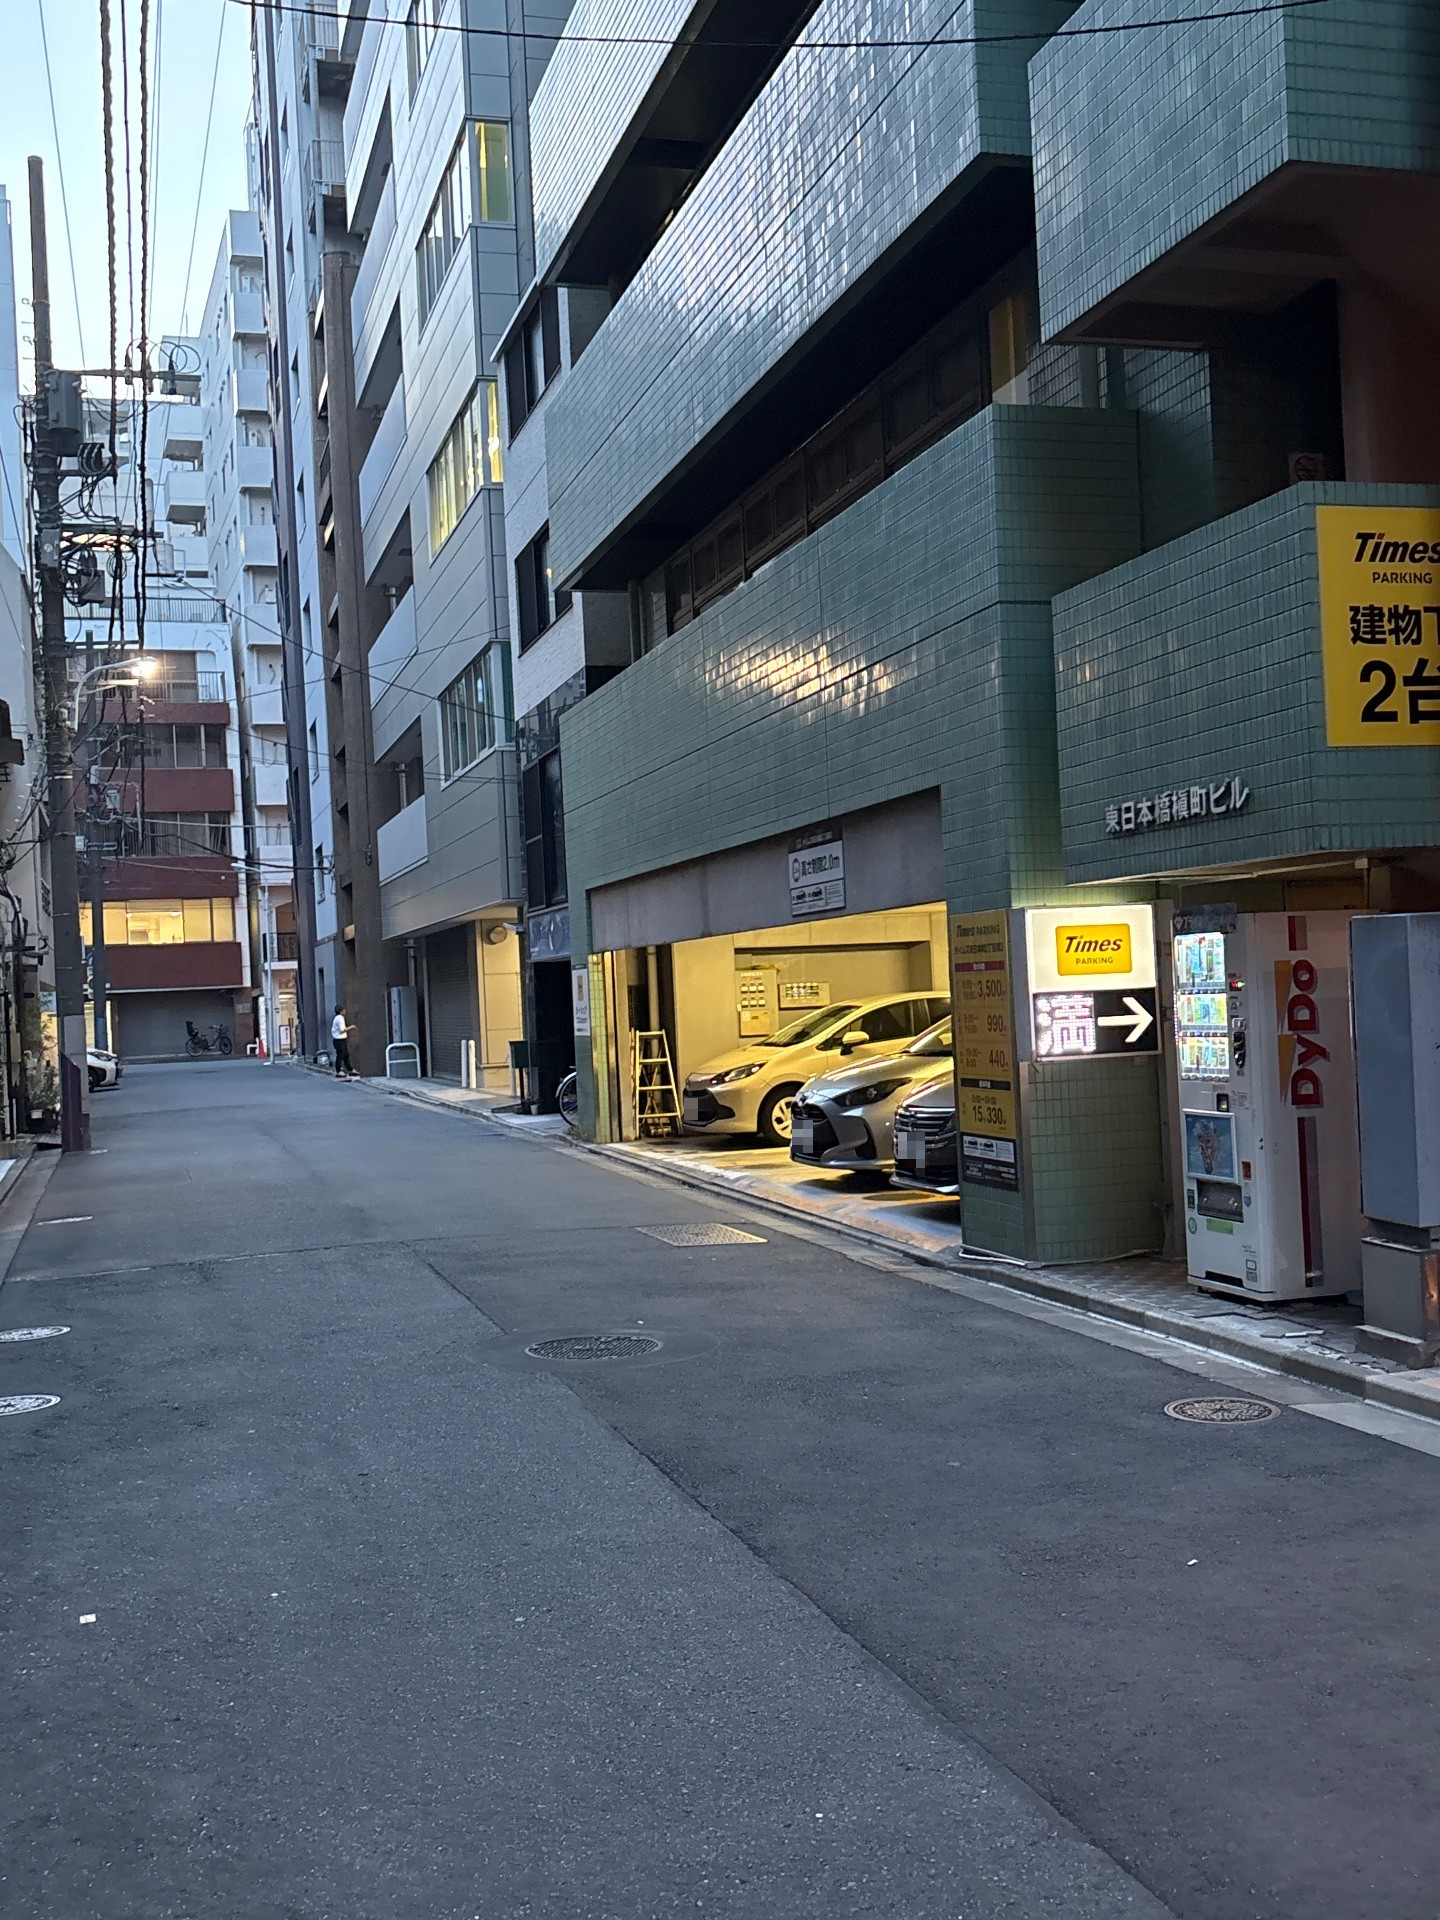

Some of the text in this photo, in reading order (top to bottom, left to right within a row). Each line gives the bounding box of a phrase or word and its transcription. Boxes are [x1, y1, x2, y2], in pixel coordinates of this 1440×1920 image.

[1354, 532, 1440, 564] Times
[1372, 572, 1433, 584] PARKING
[1065, 935, 1123, 953] Times
[1075, 956, 1114, 965] PARKING
[1037, 995, 1097, 1056] 満
